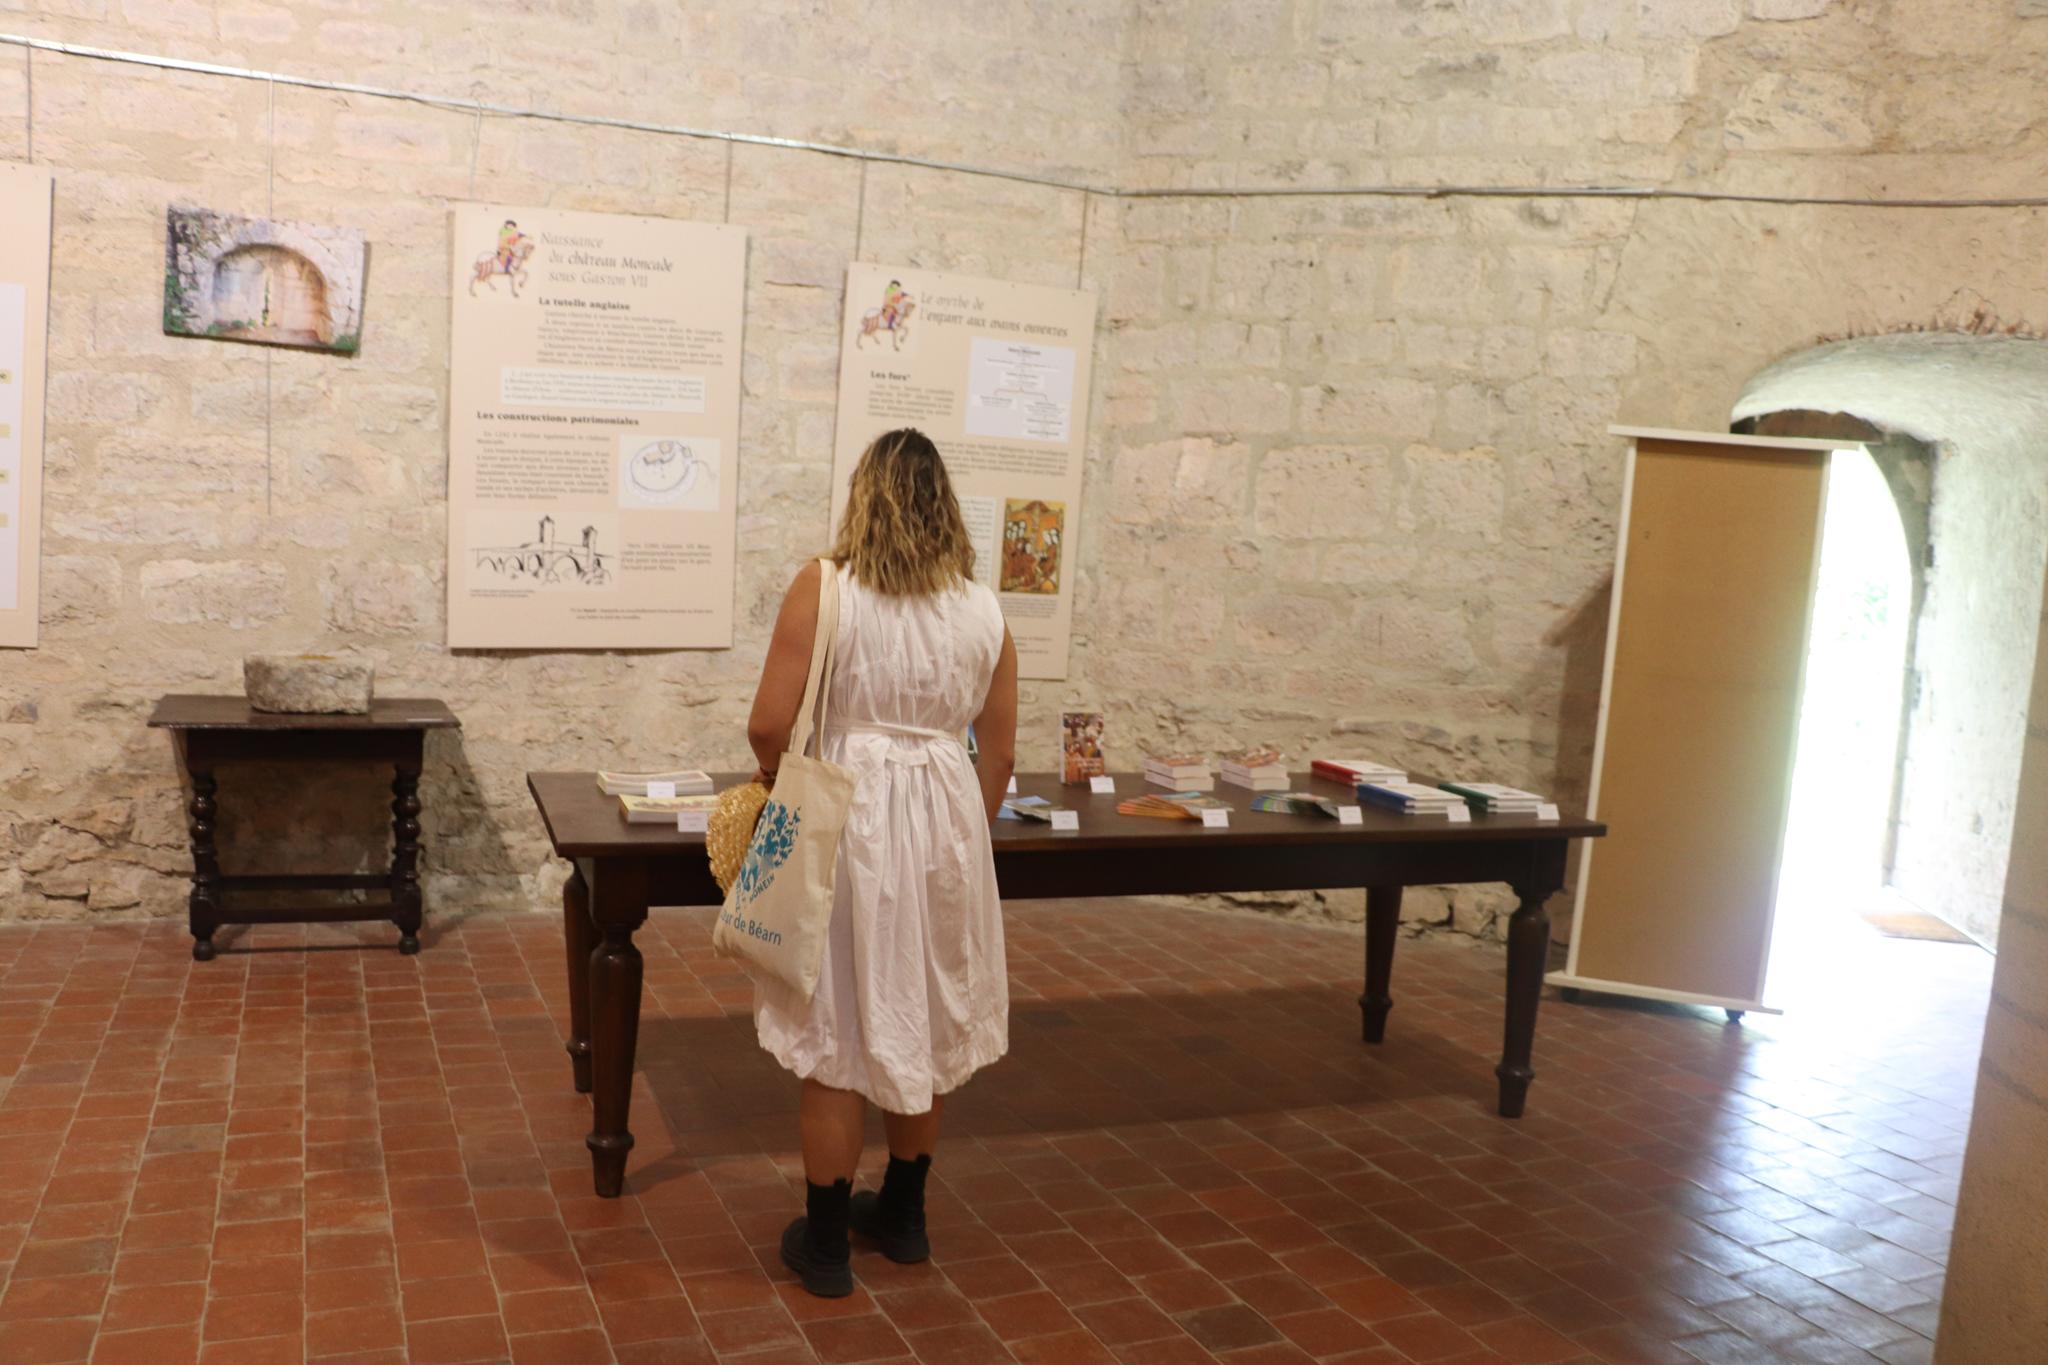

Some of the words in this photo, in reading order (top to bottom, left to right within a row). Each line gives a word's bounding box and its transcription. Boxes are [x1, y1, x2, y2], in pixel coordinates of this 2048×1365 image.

[540, 233, 604, 249] Naissance
[568, 251, 617, 268] château
[622, 257, 673, 273] Moncade
[548, 272, 576, 284] sous
[581, 272, 626, 287] Gaston
[538, 297, 550, 306] La
[553, 298, 586, 308] tutelle
[589, 300, 631, 311] anglaise
[920, 292, 932, 304] Le
[973, 297, 984, 310] de
[966, 316, 987, 328] aux
[871, 370, 886, 379] Les
[477, 411, 494, 420] Les
[498, 413, 568, 423] constructions
[571, 415, 640, 427] patrimoniales
[734, 913, 746, 932] de
[748, 920, 782, 946] Béarn
